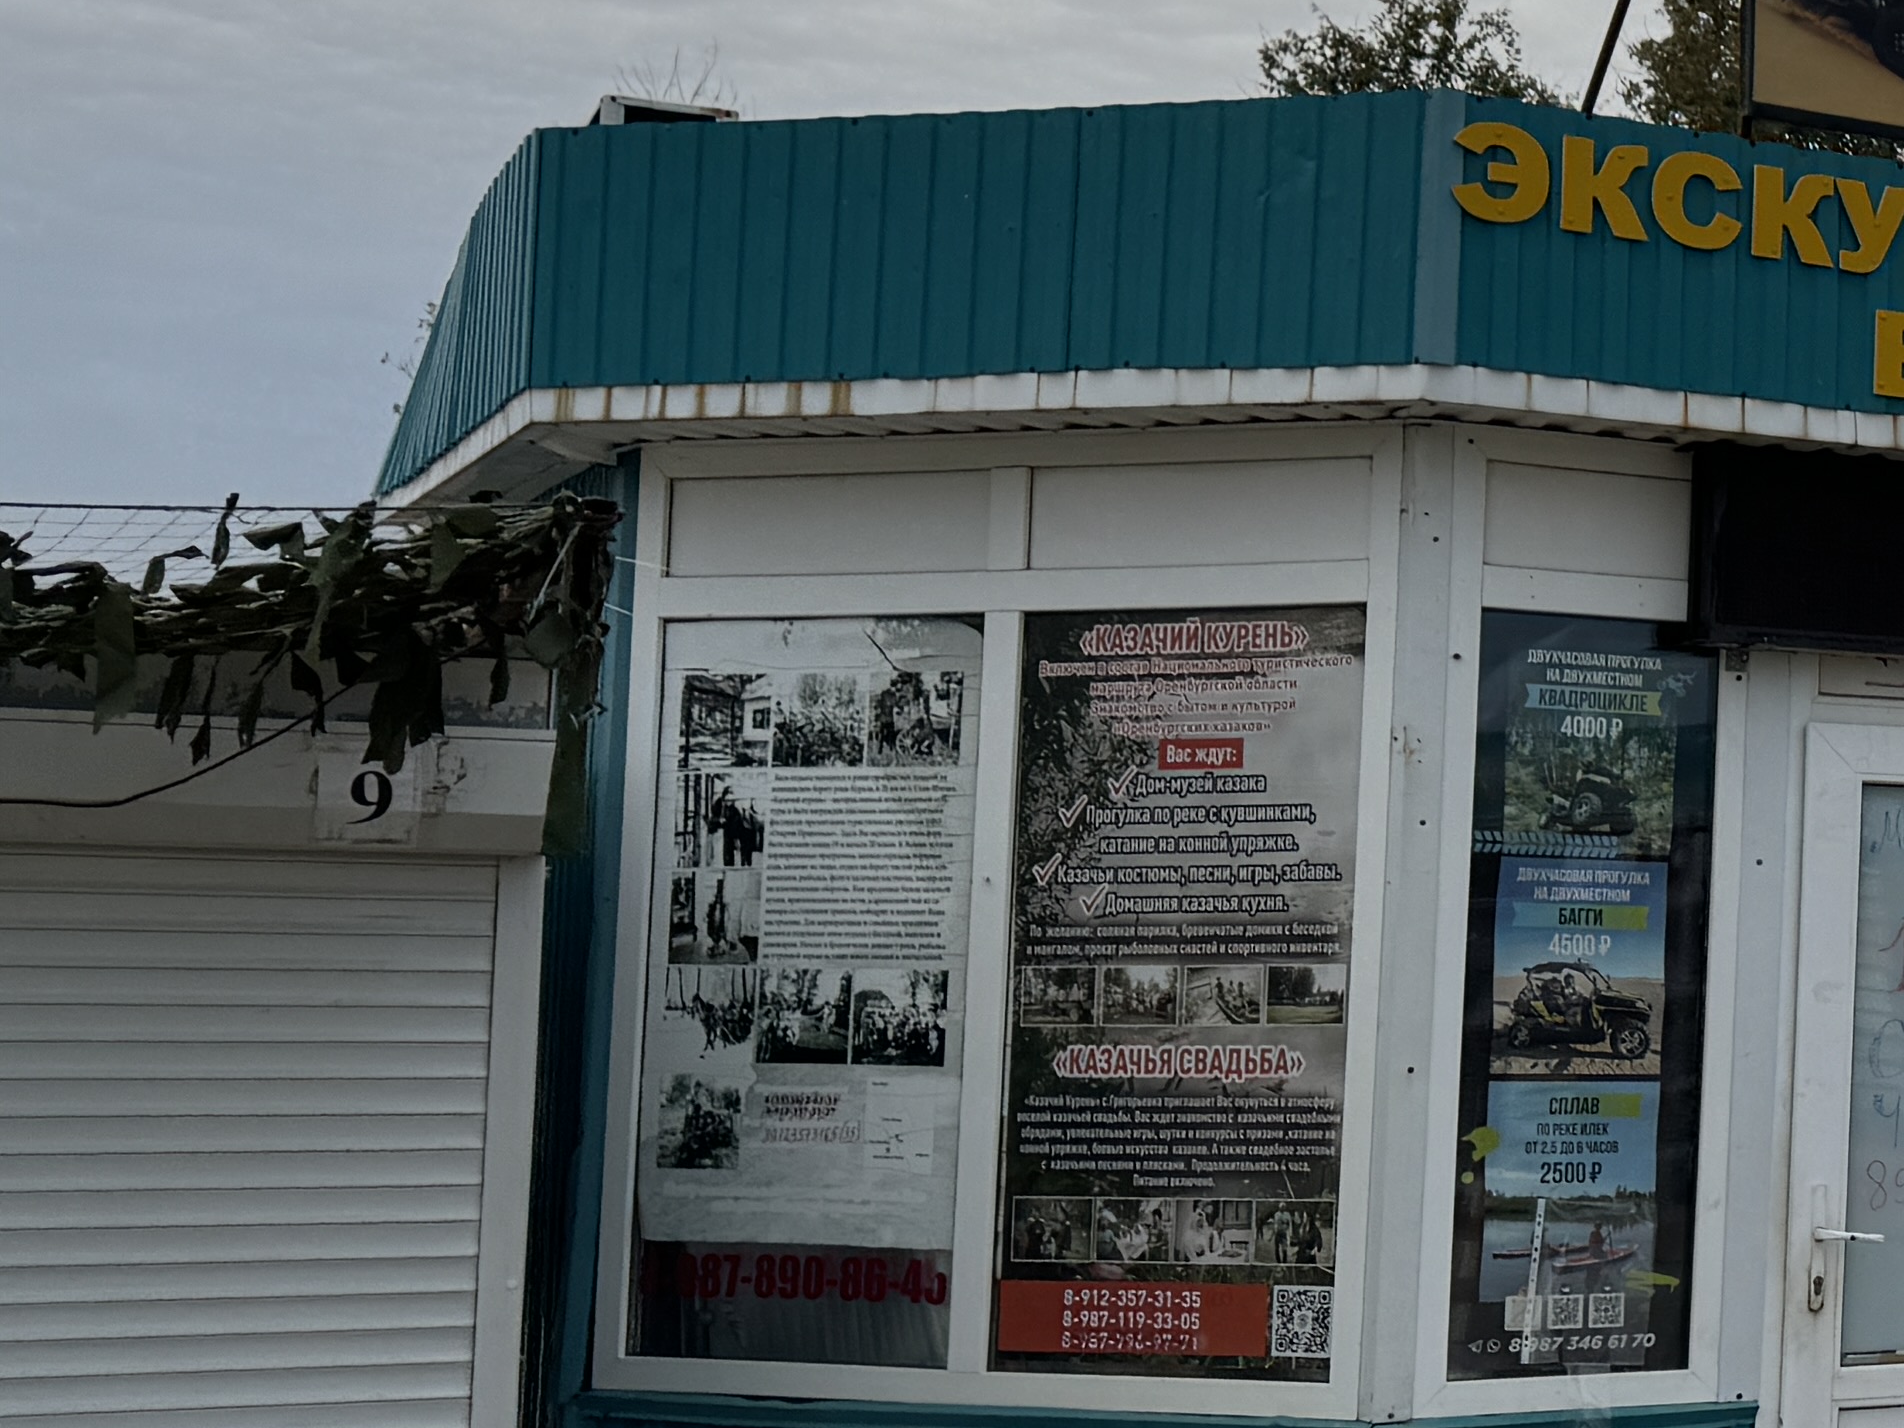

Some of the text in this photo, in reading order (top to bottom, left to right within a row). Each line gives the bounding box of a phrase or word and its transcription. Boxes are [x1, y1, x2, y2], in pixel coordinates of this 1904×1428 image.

[1079, 618, 1310, 655] «КАЗАЧИЙ КУРЕНЬ»
[1547, 668, 1643, 688] НА ДВУХМЕСТНОМ
[1538, 688, 1648, 712] КВАДРОЦИКЛЕ
[1560, 715, 1607, 738] 4000
[1166, 745, 1237, 765] Вас ждут:
[1135, 772, 1266, 796] Дом-музей казака
[347, 770, 394, 824] 9
[1086, 804, 1317, 828] Прогулка по реке с кувшинками,
[1100, 832, 1299, 856] катание на конной упряжке.
[1057, 860, 1343, 886] Казачьи костюмы, песни, игры, забавы.
[1516, 867, 1650, 885] ДВУХЧАСОВАЯ ПРОГУЛКА
[1105, 893, 1289, 916] Домашняя казачья кухня.
[1533, 886, 1630, 902] НА ДВУХМЕСТНОМ
[1558, 907, 1603, 926] БАГГИ
[1548, 933, 1595, 956] 4500
[1052, 1045, 1306, 1082] «КАЗАЧЬЯ СВАДЬБА»
[1549, 1097, 1600, 1115] СПЛАВ
[1537, 1123, 1610, 1136] ПО РЕКЕ ИЛЕК
[1525, 1141, 1537, 1154] ОТ
[1559, 1141, 1575, 1155] ДО
[1576, 1141, 1584, 1154] 6
[1585, 1141, 1619, 1154] ЧАСОВ
[1540, 1162, 1586, 1184] 2500
[1063, 1289, 1201, 1309] 8-912-357-31-35
[1062, 1311, 1200, 1330] 8-987-119-33-05
[1508, 1333, 1656, 1352] 8 987 346 61 70
